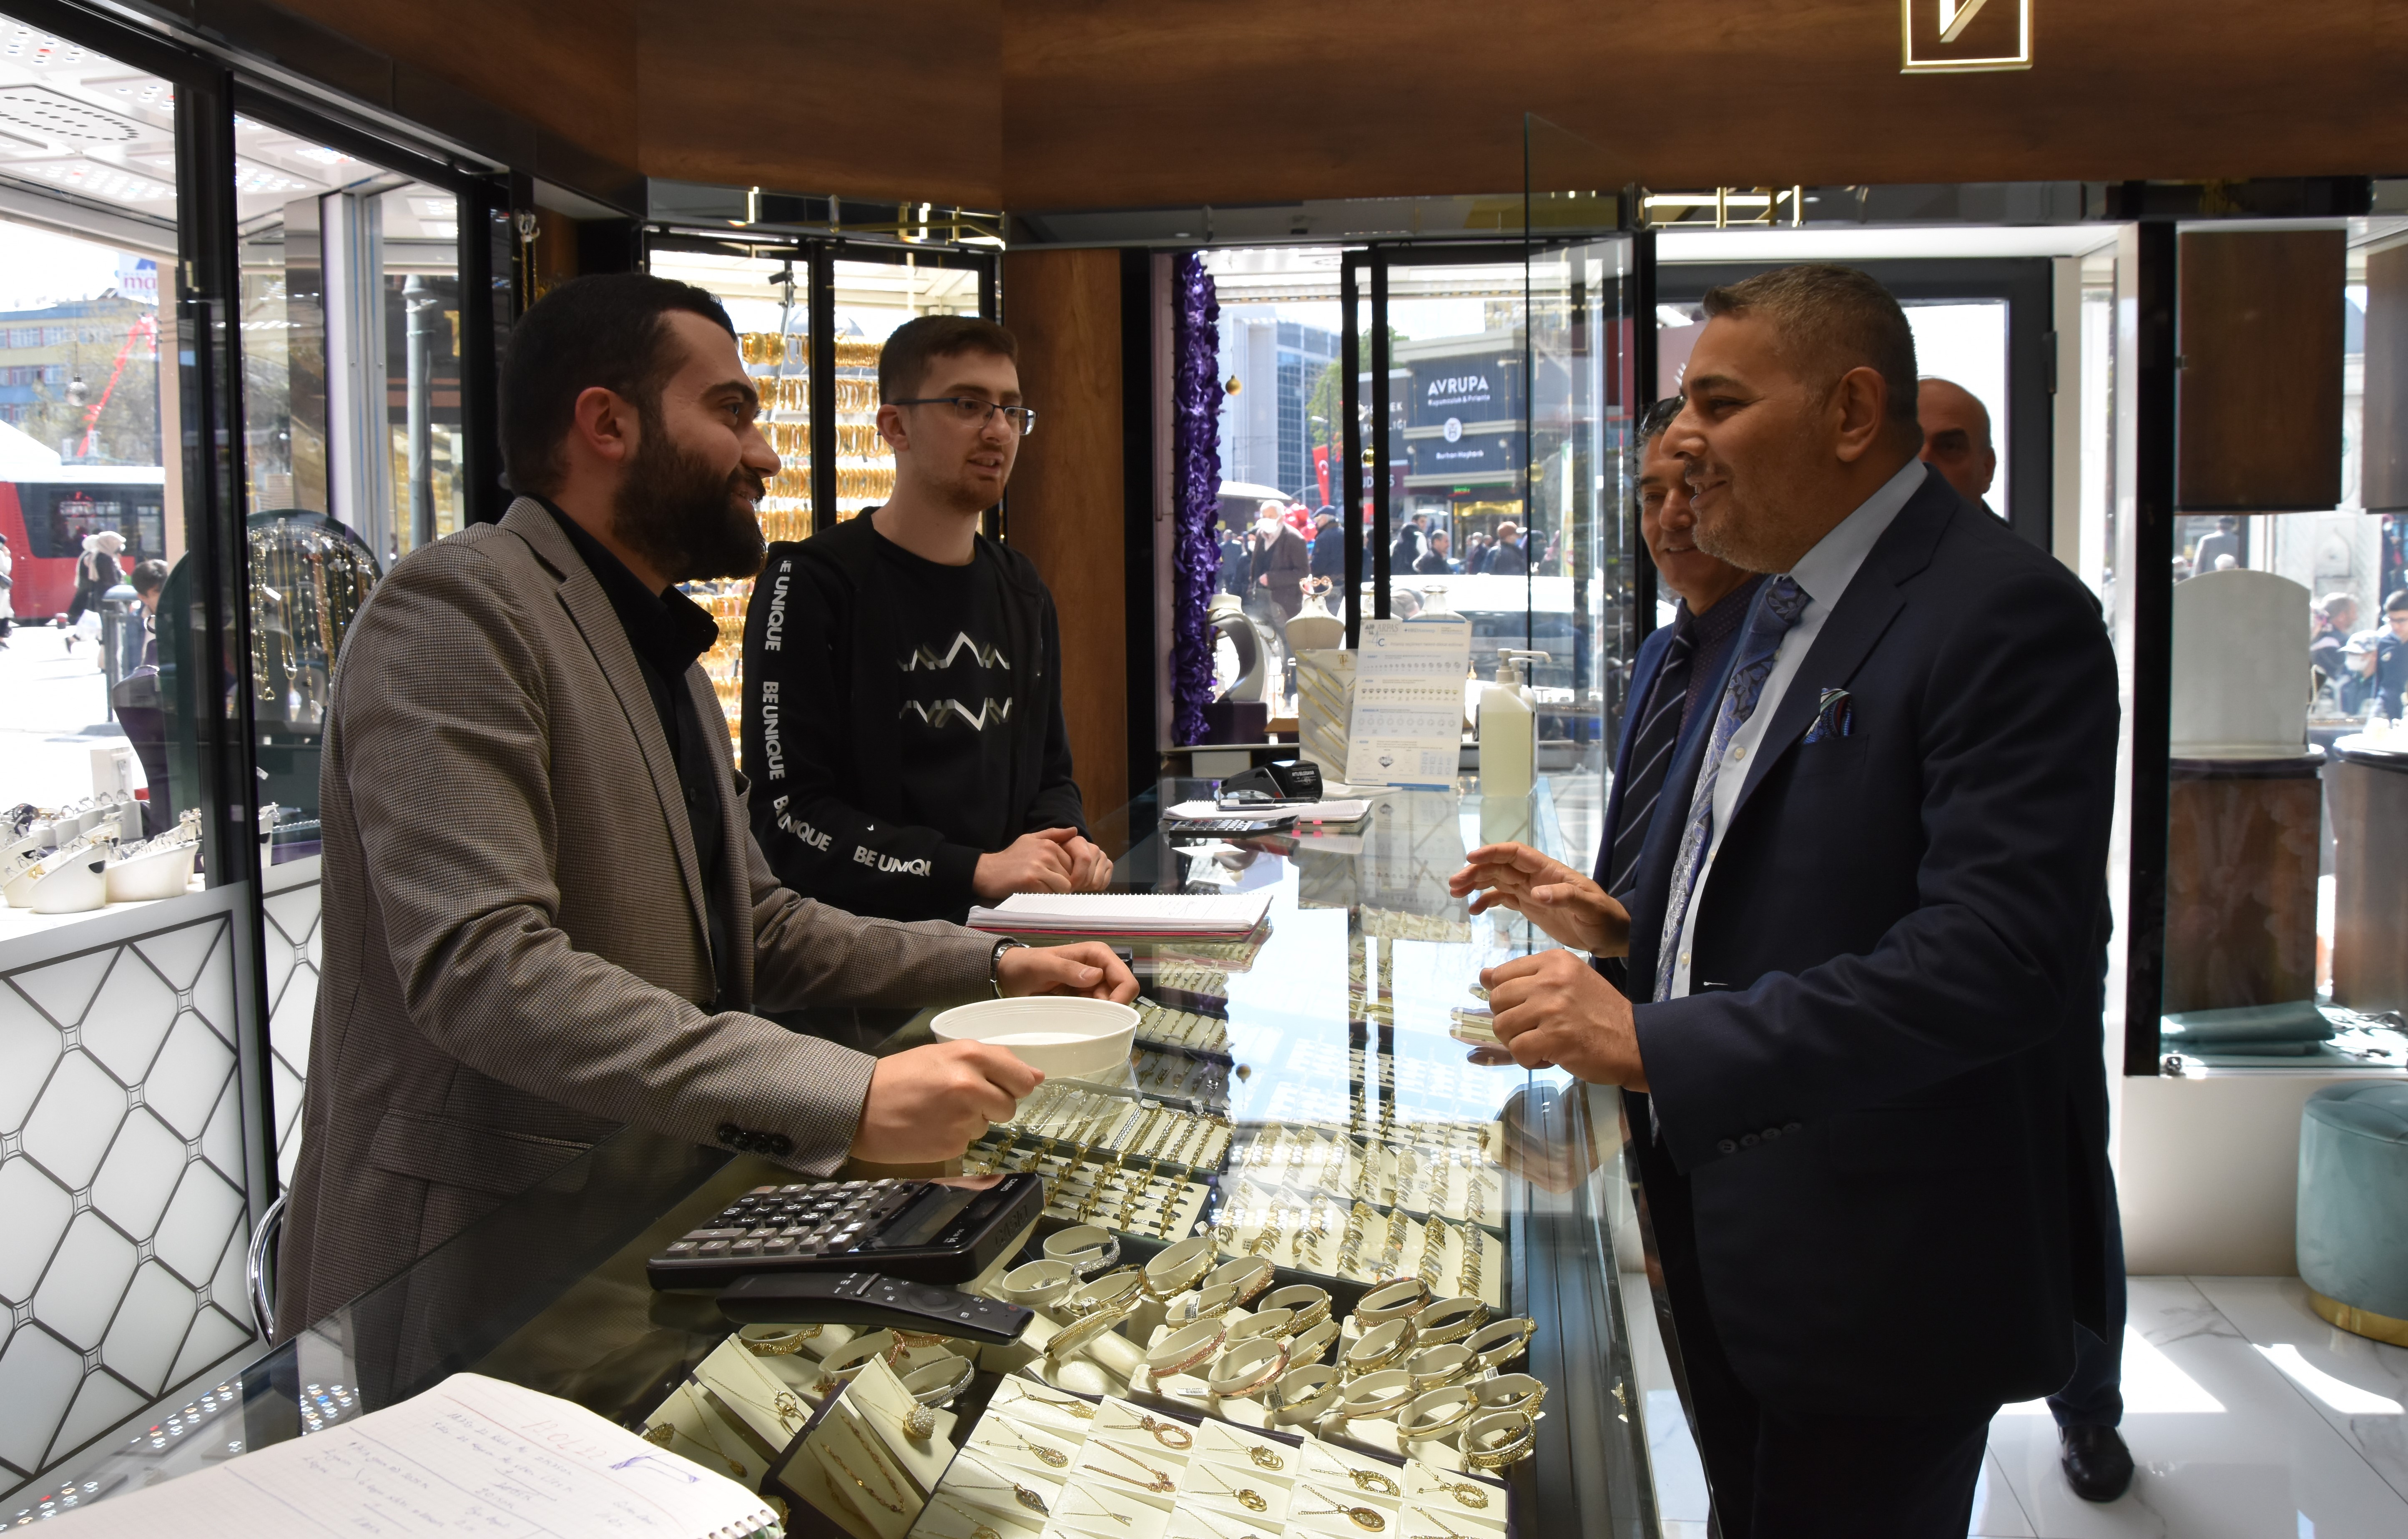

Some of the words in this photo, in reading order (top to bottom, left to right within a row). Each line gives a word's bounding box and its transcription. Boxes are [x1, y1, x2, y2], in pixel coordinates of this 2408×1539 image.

[1428, 375, 1489, 396] AVRUPA
[765, 576, 790, 651] UNIQUE
[763, 681, 779, 703] BE
[762, 705, 785, 780] UNIQUE
[853, 845, 878, 867] BE
[1000, 1178, 1018, 1192] CASIO
